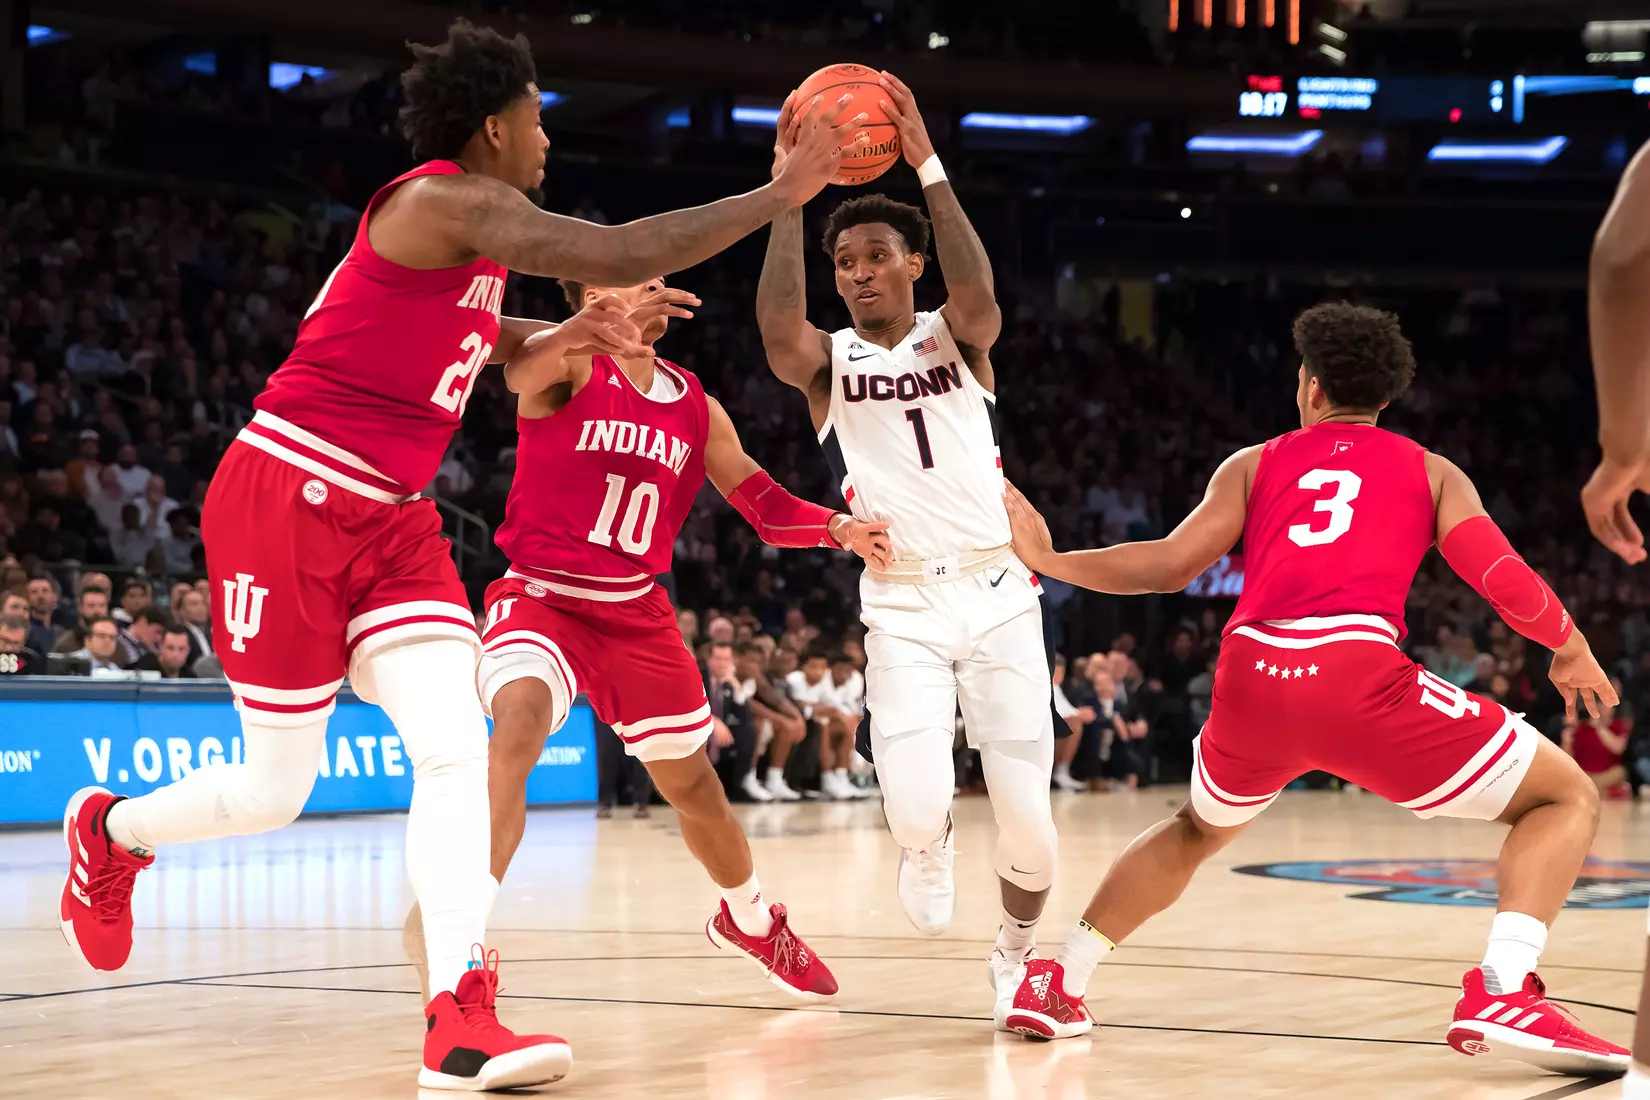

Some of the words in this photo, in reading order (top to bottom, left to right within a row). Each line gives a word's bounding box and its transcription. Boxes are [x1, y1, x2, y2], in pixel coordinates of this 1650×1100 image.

[841, 361, 963, 403] UCONN
[575, 420, 691, 478] INDIAN
[905, 407, 934, 469] 1
[588, 473, 659, 556] 10
[1288, 469, 1362, 547] 3
[1038, 971, 1053, 1000] adidas
